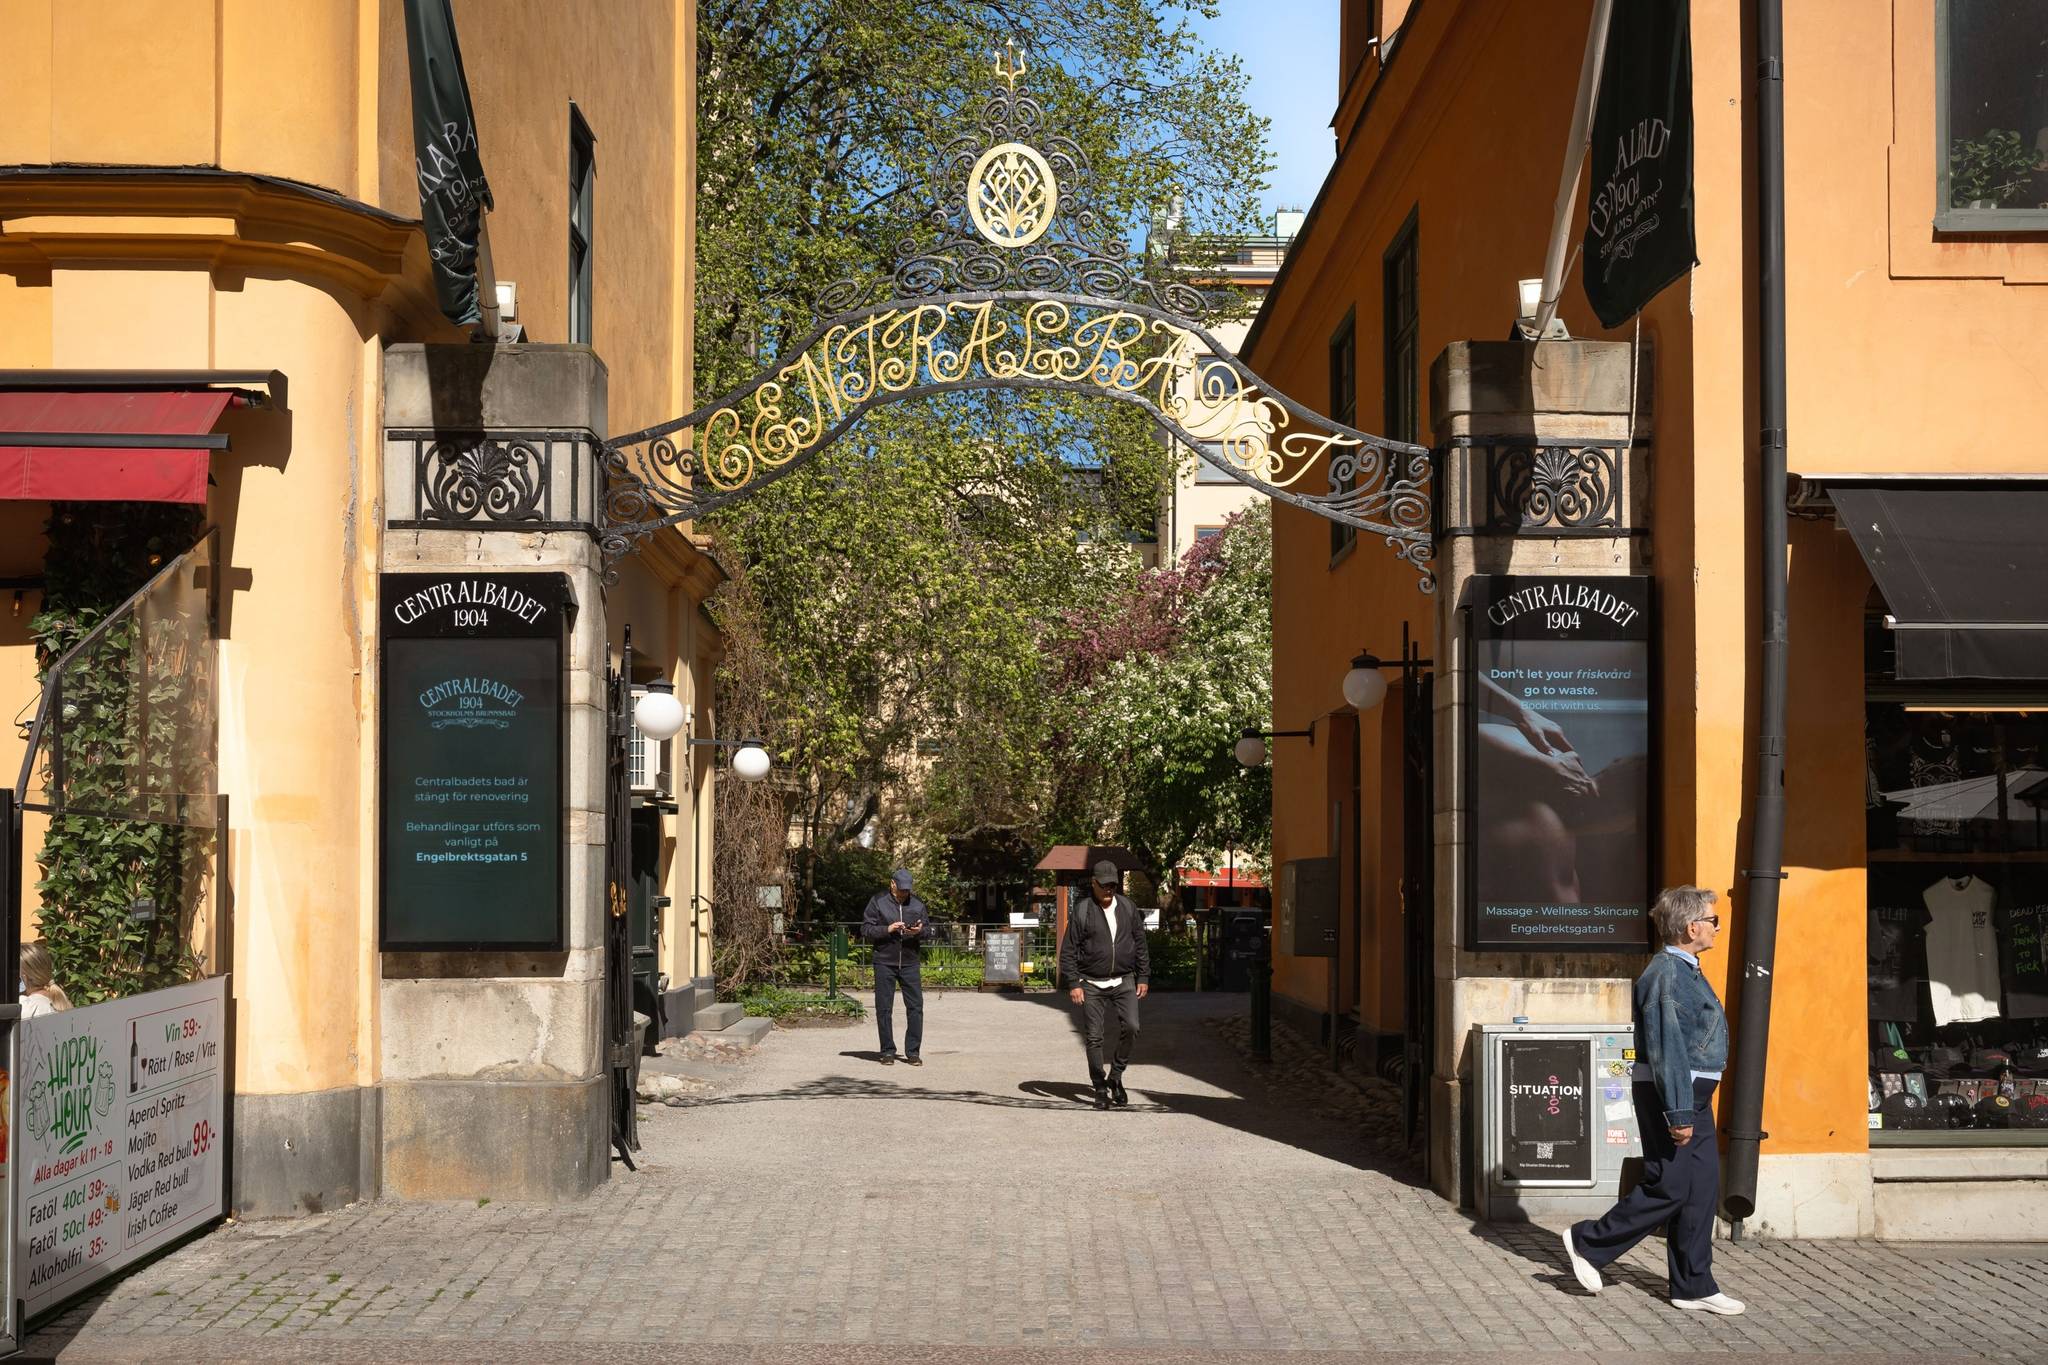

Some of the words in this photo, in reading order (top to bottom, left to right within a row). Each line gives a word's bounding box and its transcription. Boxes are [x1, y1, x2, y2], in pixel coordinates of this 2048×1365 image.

[703, 299, 1362, 489] CENTRALBADET
[394, 580, 547, 625] CENTRALBADET
[453, 608, 489, 627] 1904
[1487, 583, 1639, 628] CENTRALBADET
[1545, 611, 1581, 629] 1904
[1490, 668, 1524, 679] Don't
[1527, 668, 1543, 679] let
[1546, 670, 1573, 681] your
[1576, 668, 1632, 679] friskvård
[418, 677, 525, 709] CENTRALBADET
[459, 696, 483, 709] 1904
[1524, 687, 1540, 697] go
[1542, 685, 1555, 695] to
[1558, 686, 1598, 695] waste.
[415, 777, 492, 787] Centralbadets
[494, 777, 515, 787] bad
[517, 777, 528, 787] är
[415, 792, 450, 803] stängt
[453, 792, 468, 801] för
[470, 792, 529, 803] renovering
[406, 822, 480, 834] Behandlingar
[482, 822, 514, 832] utförs
[516, 824, 541, 832] som
[444, 837, 482, 848] vanligt
[484, 836, 499, 848] på
[416, 852, 518, 864] Engelbrektsgatan
[520, 852, 528, 862] 5
[1486, 906, 1533, 917] Massage
[1593, 906, 1639, 916] Skincare
[1511, 924, 1606, 935] Engelbrektsgatan
[1608, 924, 1615, 934] 5
[165, 1022, 181, 1043] Vin
[183, 1018, 201, 1039] 59:-
[47, 1035, 98, 1092] HAPPY
[148, 1056, 167, 1076] Rött
[174, 1050, 194, 1068] Rose
[202, 1041, 216, 1058] Vitt
[1509, 1085, 1582, 1096] SITUATION
[50, 1083, 93, 1140] HOUR
[128, 1099, 159, 1130] Aperol
[160, 1093, 185, 1118] Spritz
[128, 1131, 157, 1156] Mojito
[192, 1119, 216, 1158] 99:-
[33, 1165, 51, 1185] Alla
[53, 1156, 78, 1177] dagar
[80, 1147, 88, 1166] kl
[89, 1146, 97, 1162] 11
[104, 1139, 113, 1156] 18
[128, 1156, 156, 1183] Vodka
[158, 1145, 175, 1170] Red
[175, 1140, 192, 1162] bull
[29, 1196, 57, 1227] Fatöl
[62, 1184, 86, 1211] 40cl
[88, 1179, 108, 1201] 39:-
[128, 1187, 153, 1212] Jäger
[154, 1173, 172, 1198] Red
[172, 1167, 189, 1189] bull
[29, 1227, 57, 1258] Fatöl
[62, 1214, 85, 1242] 50cl
[88, 1208, 108, 1229] 49:-
[127, 1213, 147, 1239] Irish
[149, 1202, 178, 1228] Coffee
[28, 1245, 82, 1289] Alkoholfri
[88, 1237, 108, 1259] 35:-
